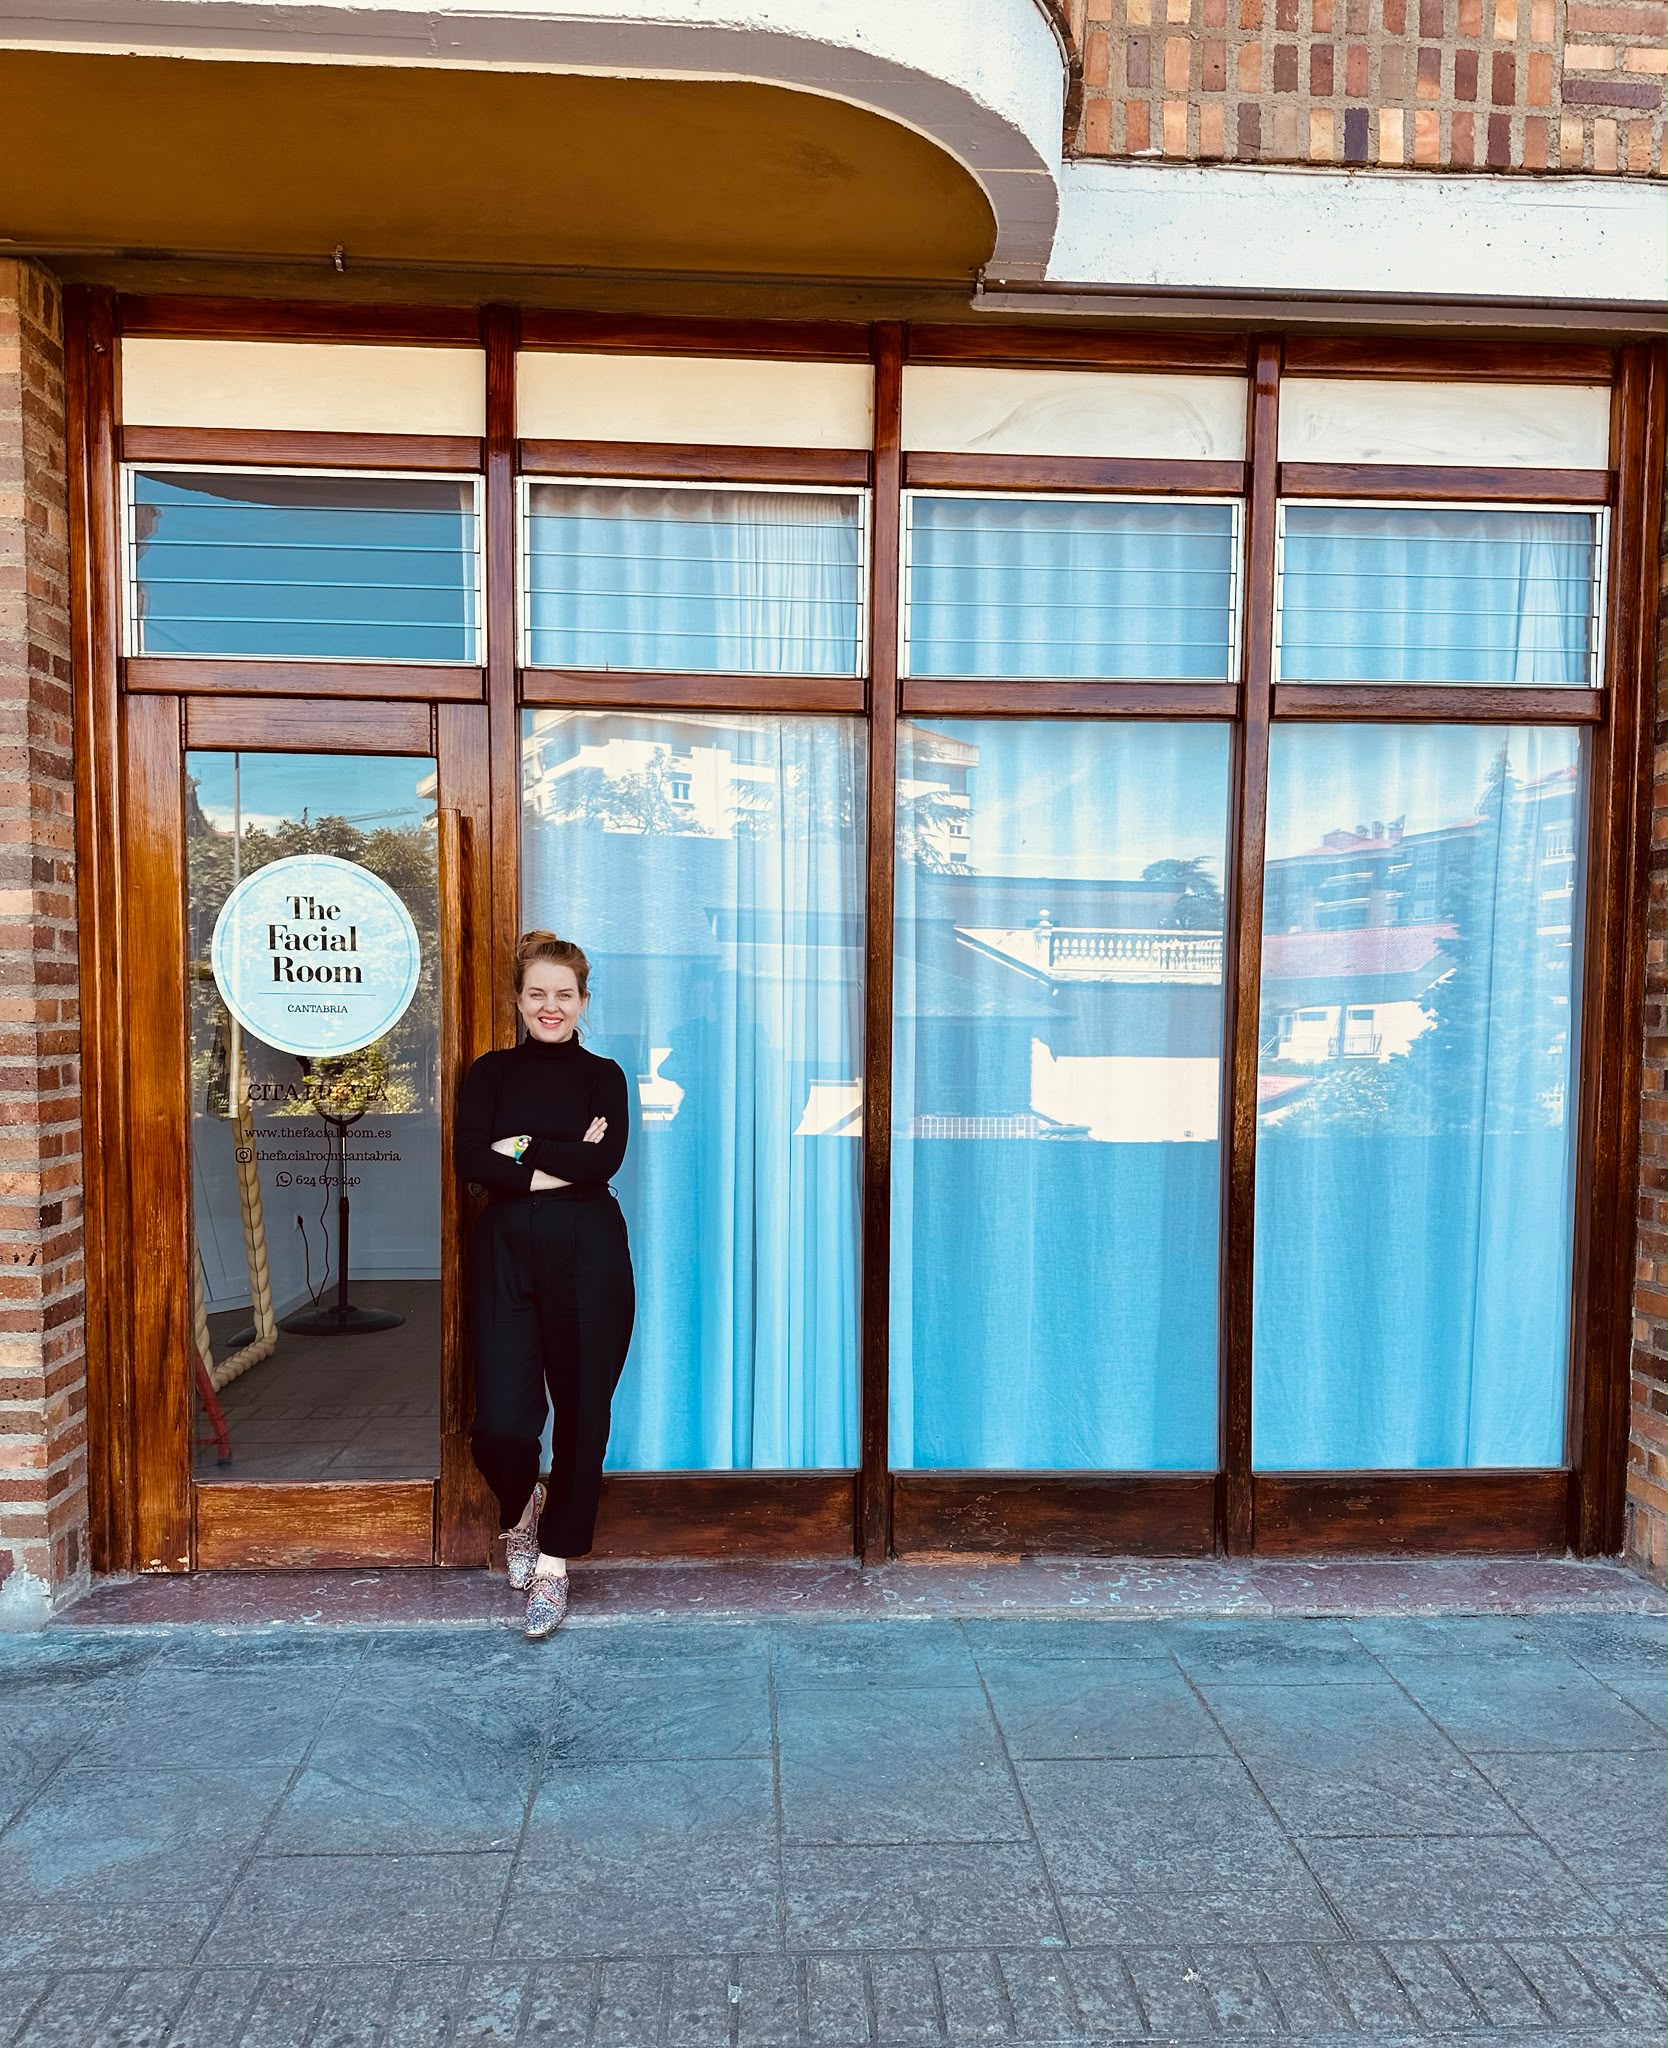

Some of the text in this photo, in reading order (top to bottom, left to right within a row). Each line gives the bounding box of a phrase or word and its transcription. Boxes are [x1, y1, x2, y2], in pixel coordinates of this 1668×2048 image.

[286, 895, 341, 921] The
[267, 924, 359, 952] Facial
[272, 956, 364, 984] Room
[287, 1004, 348, 1014] CANTABRIA
[247, 1084, 299, 1101] CITA
[244, 1127, 392, 1139] www.thefacialoom.es
[296, 1175, 361, 1187] 624 673 240
